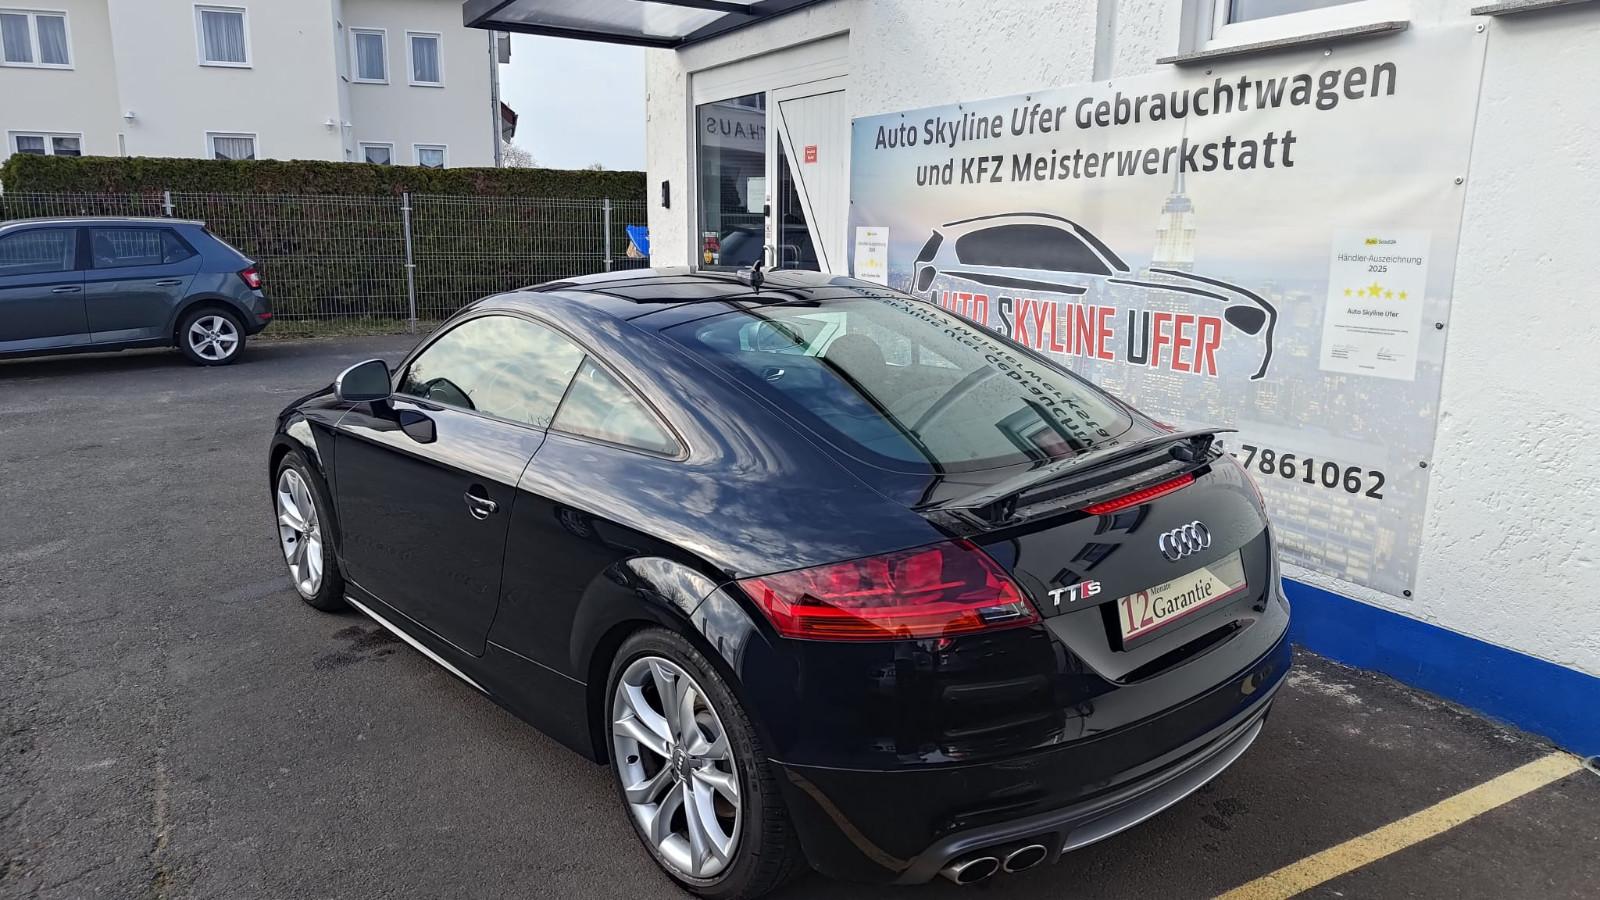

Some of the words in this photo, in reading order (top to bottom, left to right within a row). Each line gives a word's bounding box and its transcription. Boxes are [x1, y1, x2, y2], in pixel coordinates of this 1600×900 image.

[875, 121, 917, 149] Auto
[923, 112, 1003, 147] Skyline
[1010, 103, 1067, 136] Ufer
[1075, 60, 1397, 130] Gebrauchtwagen
[916, 158, 954, 186] und
[960, 155, 1004, 184] KFZ
[1011, 130, 1297, 182] Meisterwerkstatt
[1337, 253, 1423, 266] Händler-Auszeichnung
[1368, 264, 1388, 273] 2025
[1347, 307, 1361, 315] Auto
[996, 296, 1116, 362] SKYLINE
[1126, 308, 1222, 377] UFER
[1121, 590, 1154, 634] 12
